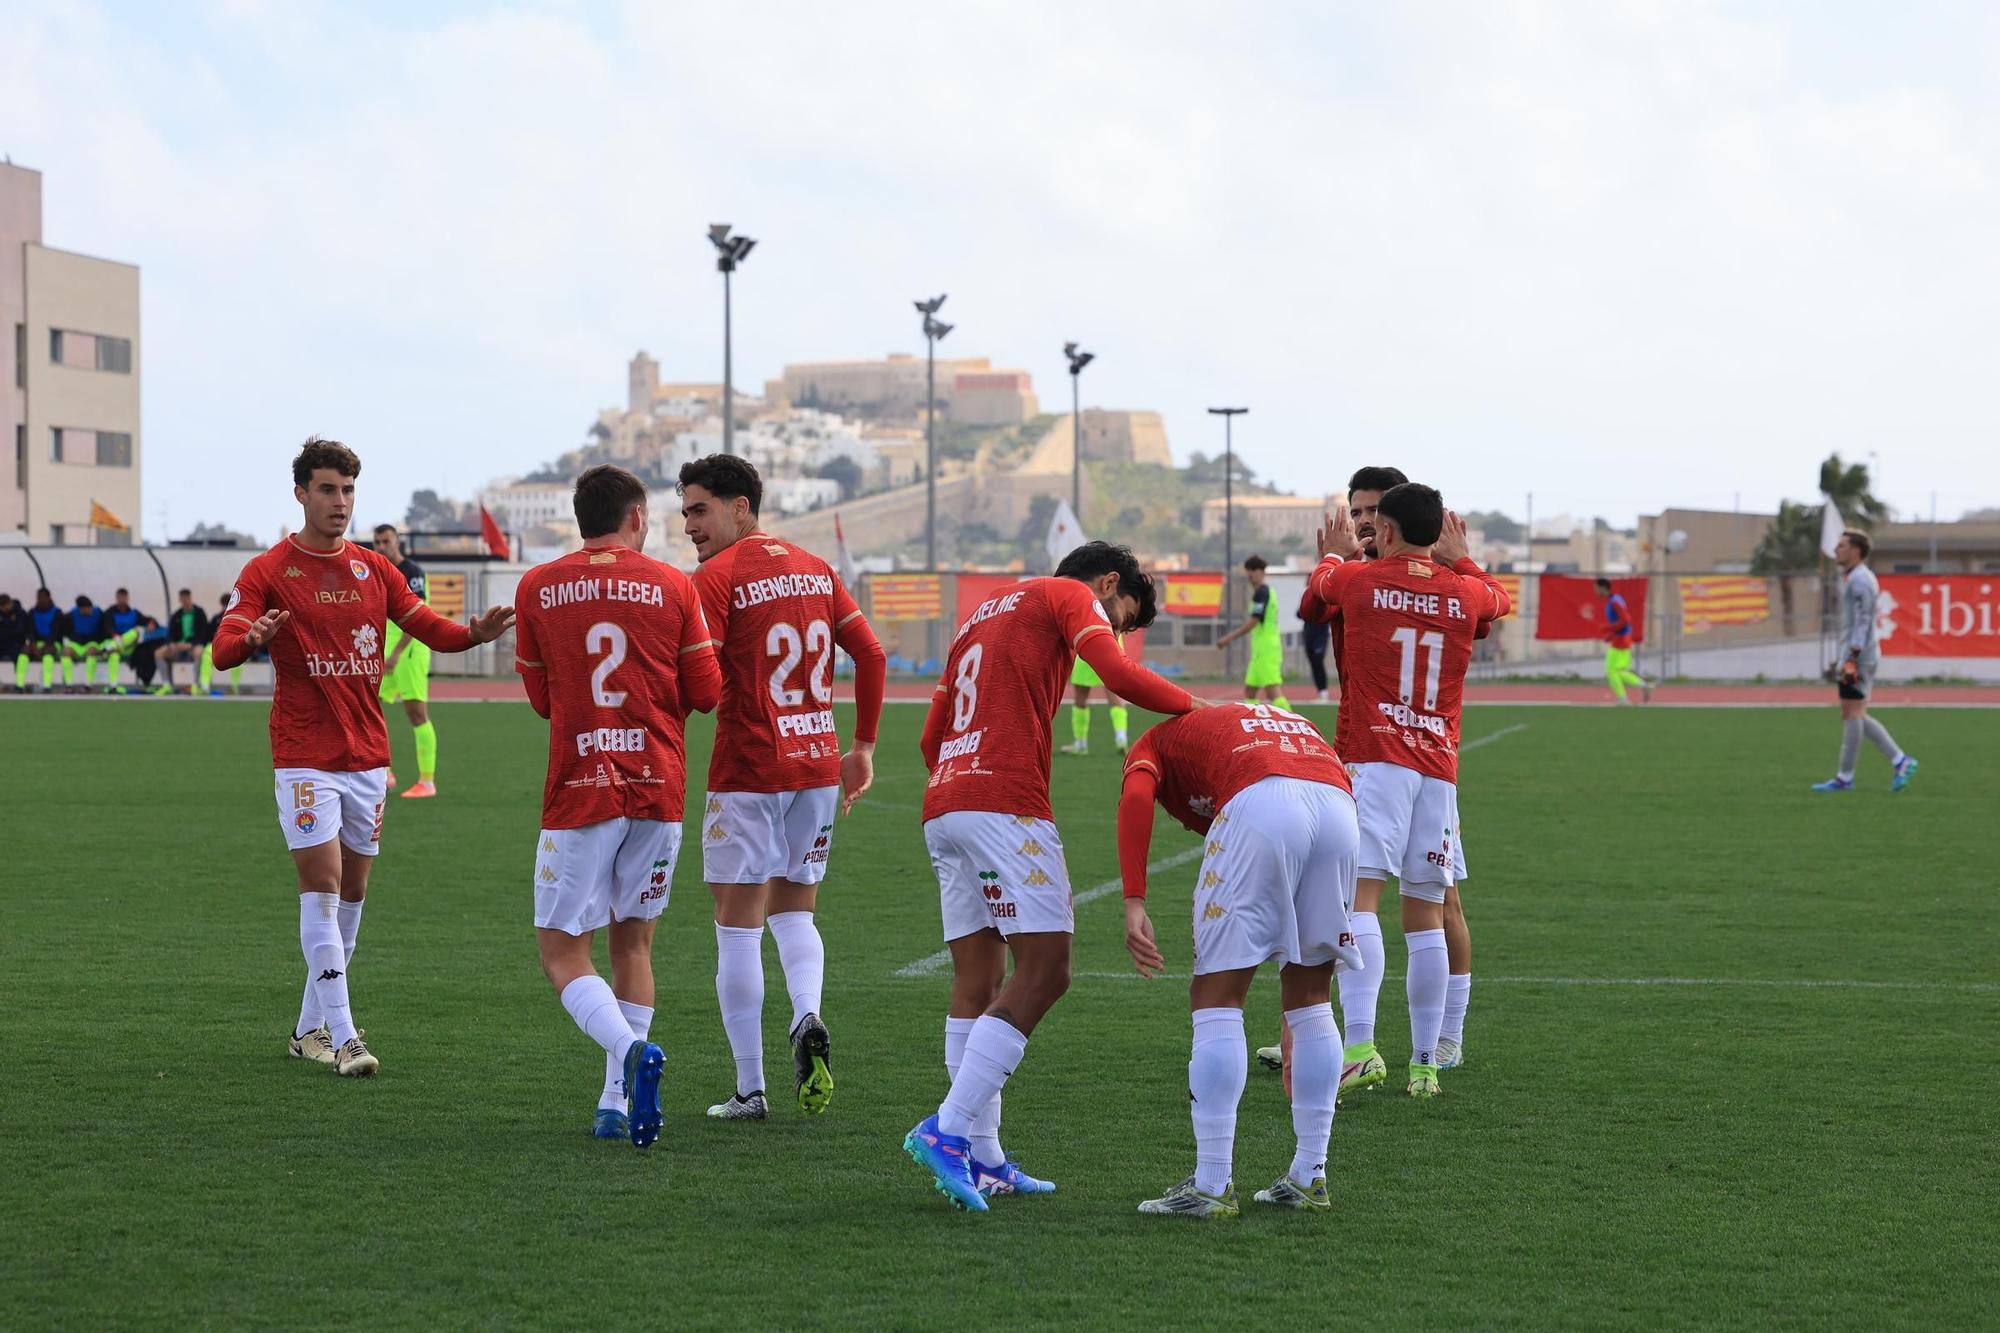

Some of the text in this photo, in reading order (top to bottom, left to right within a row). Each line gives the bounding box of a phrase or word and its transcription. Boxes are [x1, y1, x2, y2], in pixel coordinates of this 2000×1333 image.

[314, 589, 362, 604] IBIZA
[539, 575, 664, 609] SIMÓN LECEA
[1373, 588, 1467, 619] NOFRE R.
[1917, 583, 2000, 637] ibi
[306, 652, 380, 678] ibizkus
[585, 621, 629, 709] 2
[766, 619, 832, 708] 22
[1390, 626, 1445, 712] 11
[952, 643, 983, 732] 8
[777, 710, 835, 738] PACH
[1240, 718, 1326, 744] PACH
[291, 782, 316, 810] 15
